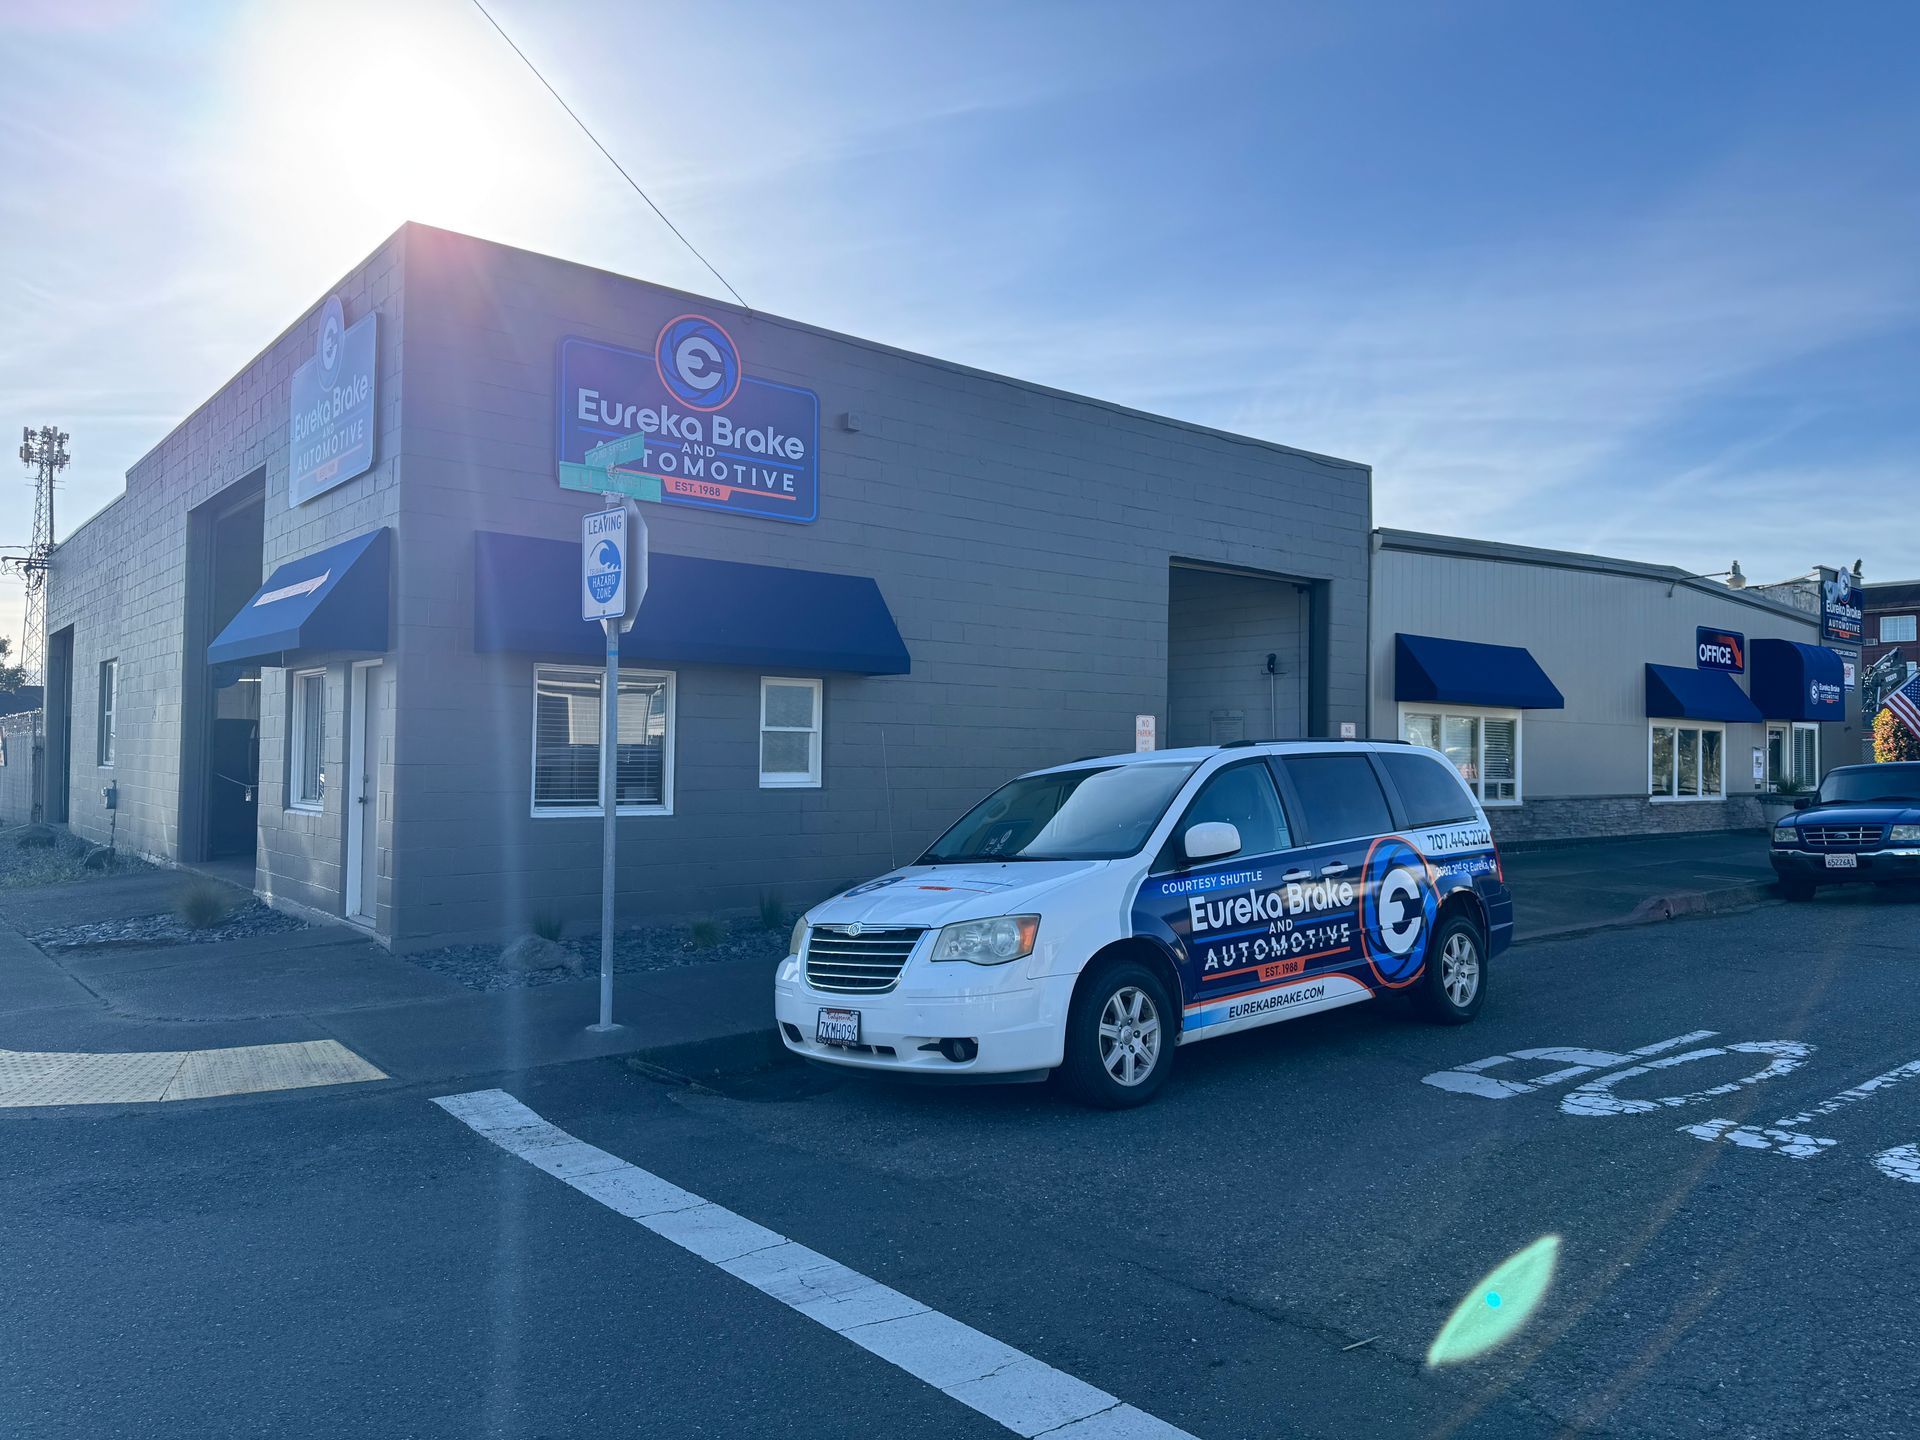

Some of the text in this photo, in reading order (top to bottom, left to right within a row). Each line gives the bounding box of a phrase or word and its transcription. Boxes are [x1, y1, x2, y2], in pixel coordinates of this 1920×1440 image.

[295, 374, 369, 443] Eureka Brake
[578, 388, 805, 459] Eureka Brake
[297, 419, 364, 474] AUTOMOTIVE
[682, 442, 716, 458] AND
[596, 440, 795, 492] TOMOTIVE
[674, 482, 721, 497] EST. 1988
[588, 515, 622, 536] LEAVING
[592, 575, 616, 588] HAZARD
[596, 587, 612, 599] ZONE
[1699, 643, 1732, 664] OFFICE
[1141, 719, 1150, 728] NO
[1427, 829, 1490, 851] 707.443.2122
[1161, 869, 1263, 895] COURTESY SHUTTLE
[1189, 878, 1353, 932] Eureka Brake
[1268, 919, 1293, 935] AND
[1204, 923, 1351, 971] AUTOMOTIVE
[1264, 961, 1299, 979] EST. 1988
[1228, 985, 1325, 1019] EUREKABRAKE.COM
[1420, 1029, 1920, 1183] TOP
